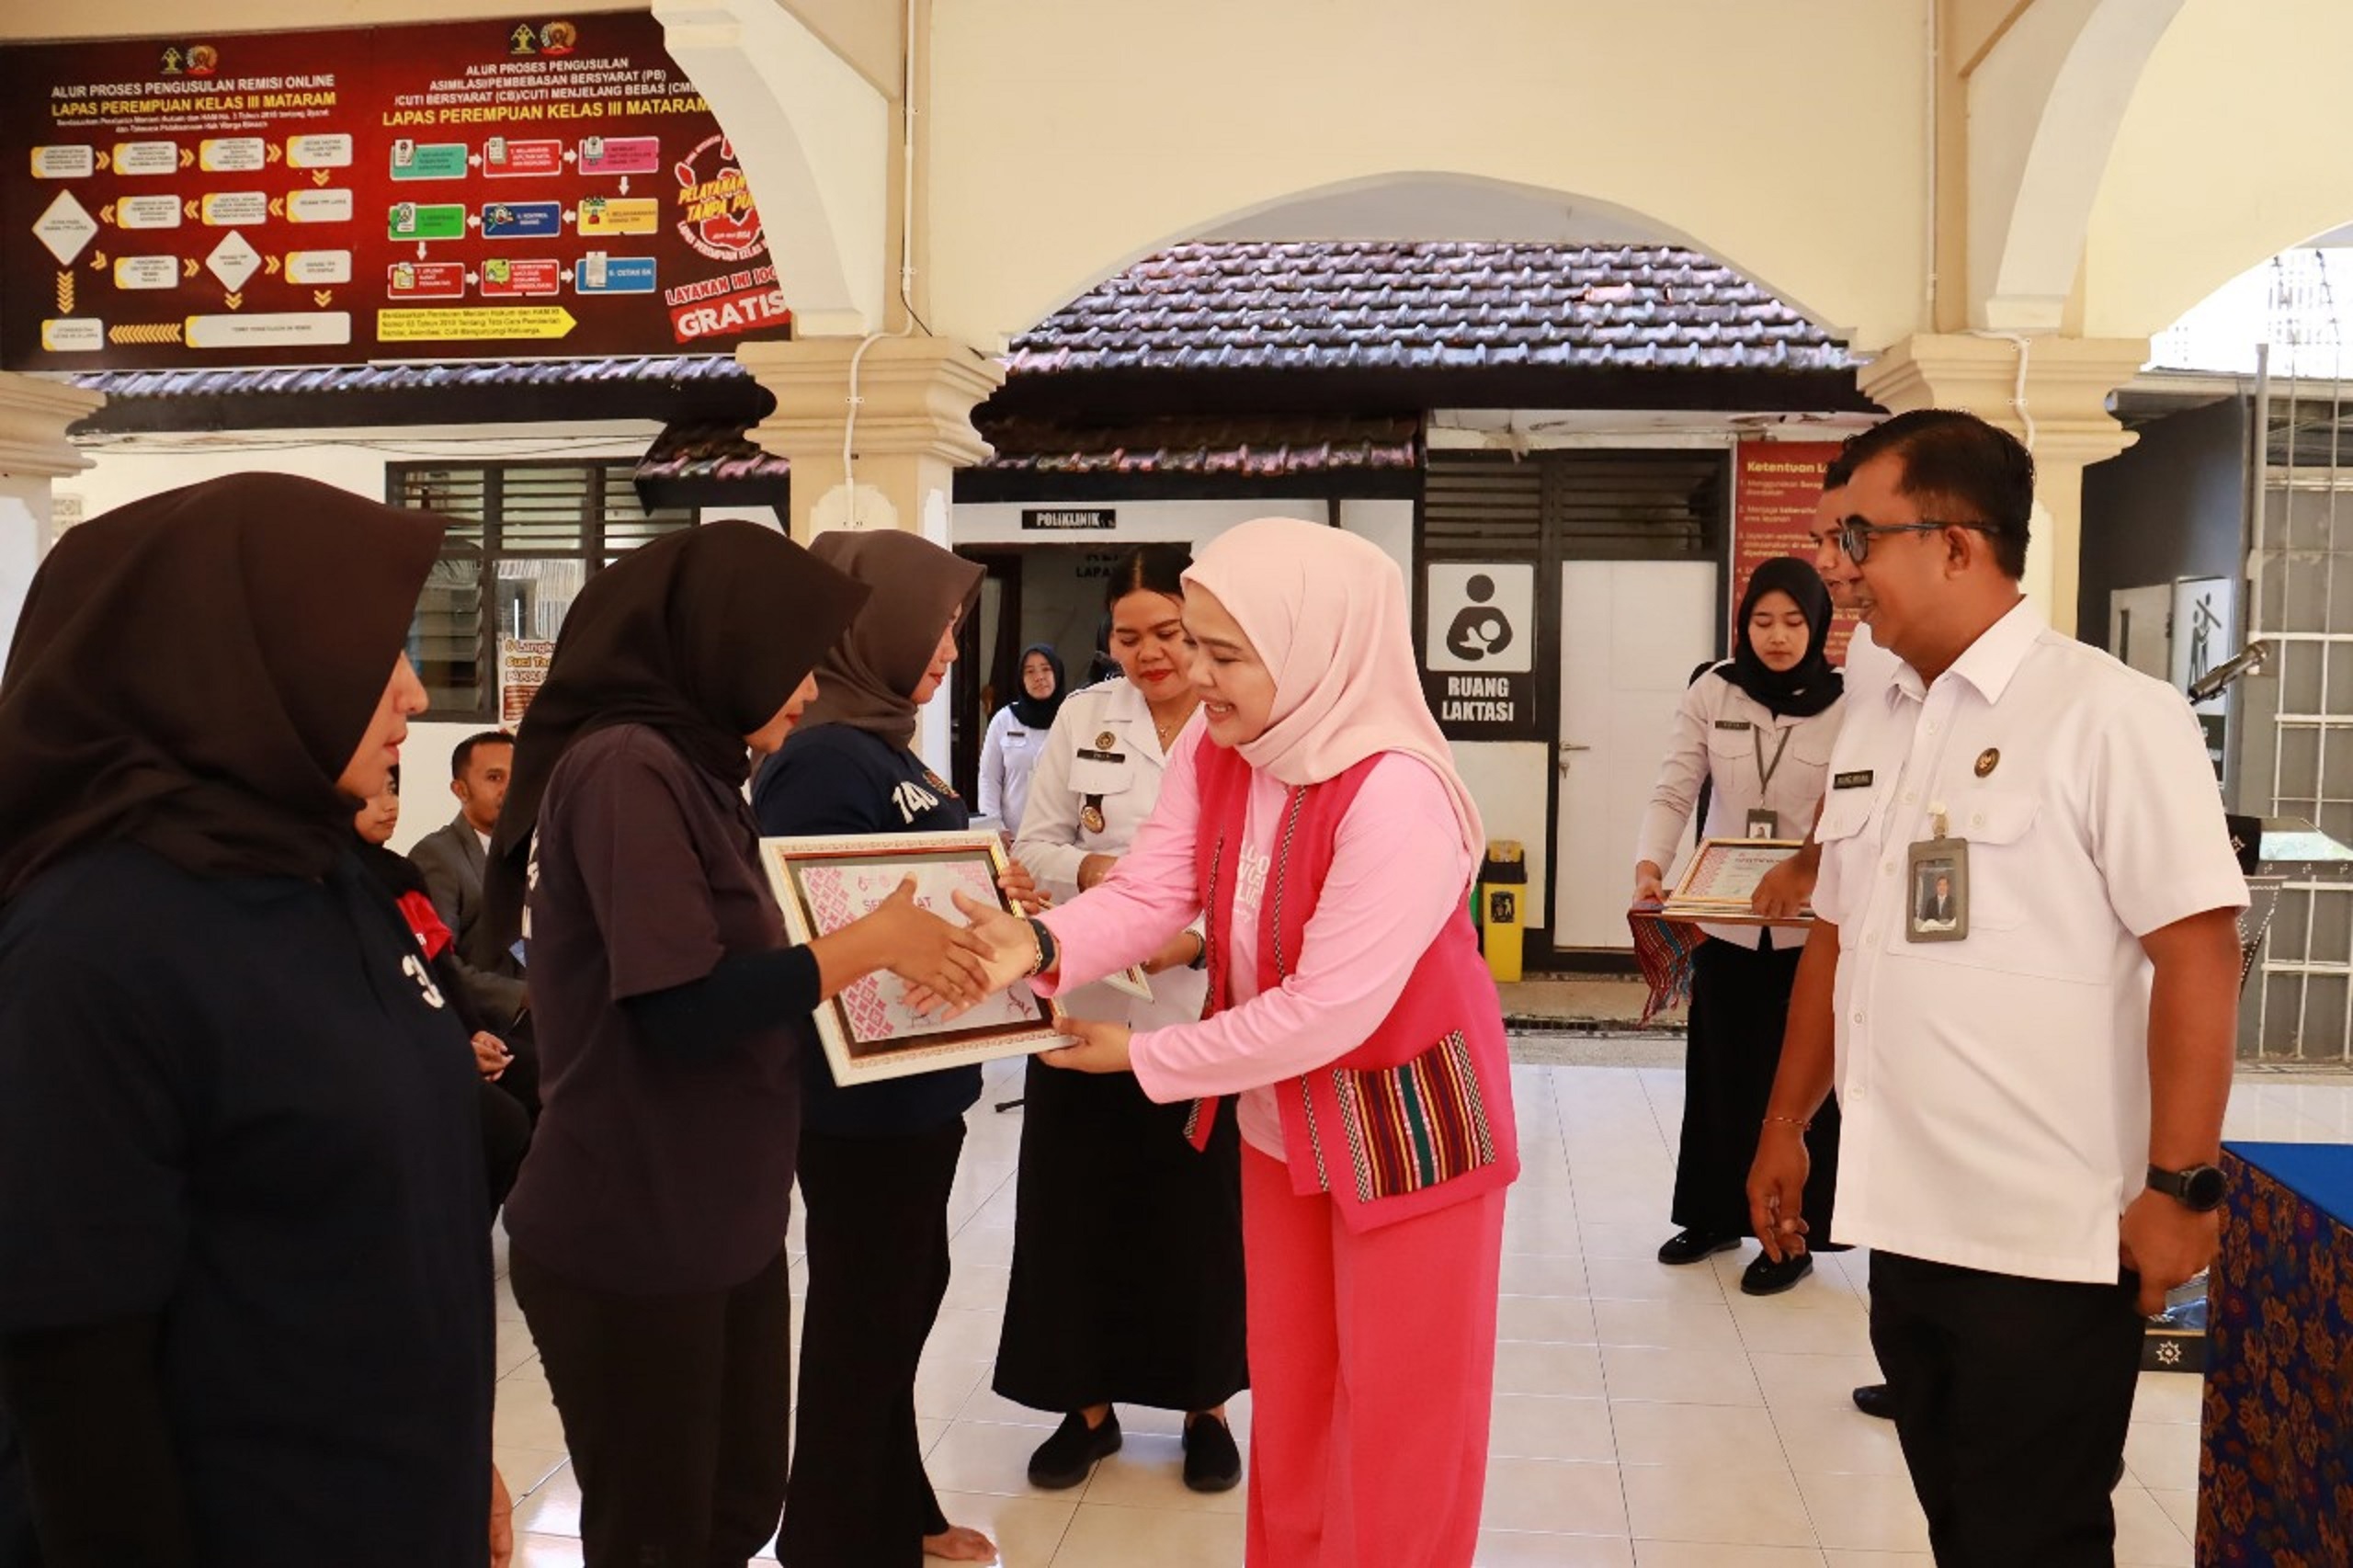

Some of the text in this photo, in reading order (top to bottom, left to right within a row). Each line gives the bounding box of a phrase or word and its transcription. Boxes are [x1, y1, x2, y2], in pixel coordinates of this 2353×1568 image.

[466, 58, 630, 76] ALUR PROSES PENGUSULAN
[570, 71, 639, 85] BERSYARAT
[642, 69, 666, 83] (PB)
[51, 74, 335, 98] ALUR PROSES PENGUSULAN REMISI ONLINE
[426, 91, 494, 106] BERSYARAT
[551, 85, 622, 99] MENJELANG
[624, 84, 665, 97] BEBAS
[51, 91, 336, 117] LAPAS PEREMPUAN KELAS III MATARAM
[382, 109, 436, 126] LAPAS
[439, 106, 543, 125] PEREMPUAN
[547, 102, 603, 119] KELAS
[608, 101, 622, 116] III
[665, 276, 731, 306] LAYANAN
[730, 270, 753, 290] INI
[677, 290, 788, 337] GRATIS
[1746, 461, 1815, 473] Ketentuan
[1036, 512, 1100, 527] POLIKLINIK
[1448, 676, 1510, 698] RUANG
[1441, 700, 1515, 722] LAKTASI
